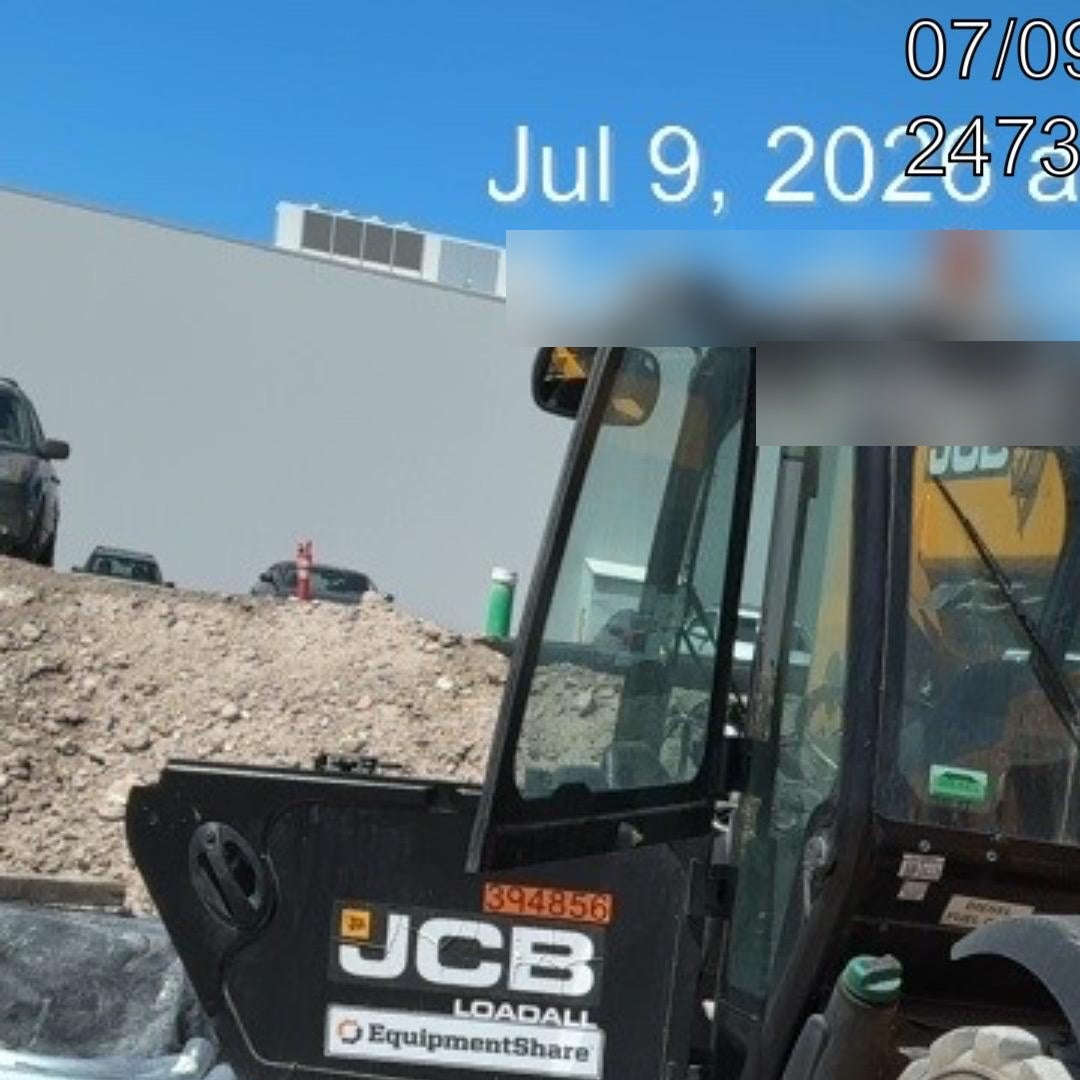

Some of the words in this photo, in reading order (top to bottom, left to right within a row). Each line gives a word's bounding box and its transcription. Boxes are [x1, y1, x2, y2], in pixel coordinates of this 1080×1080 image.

[485, 883, 610, 920] 394856
[338, 913, 595, 998] JCB
[453, 998, 598, 1029] LOADALL
[367, 1023, 590, 1063] EquipmentShare
